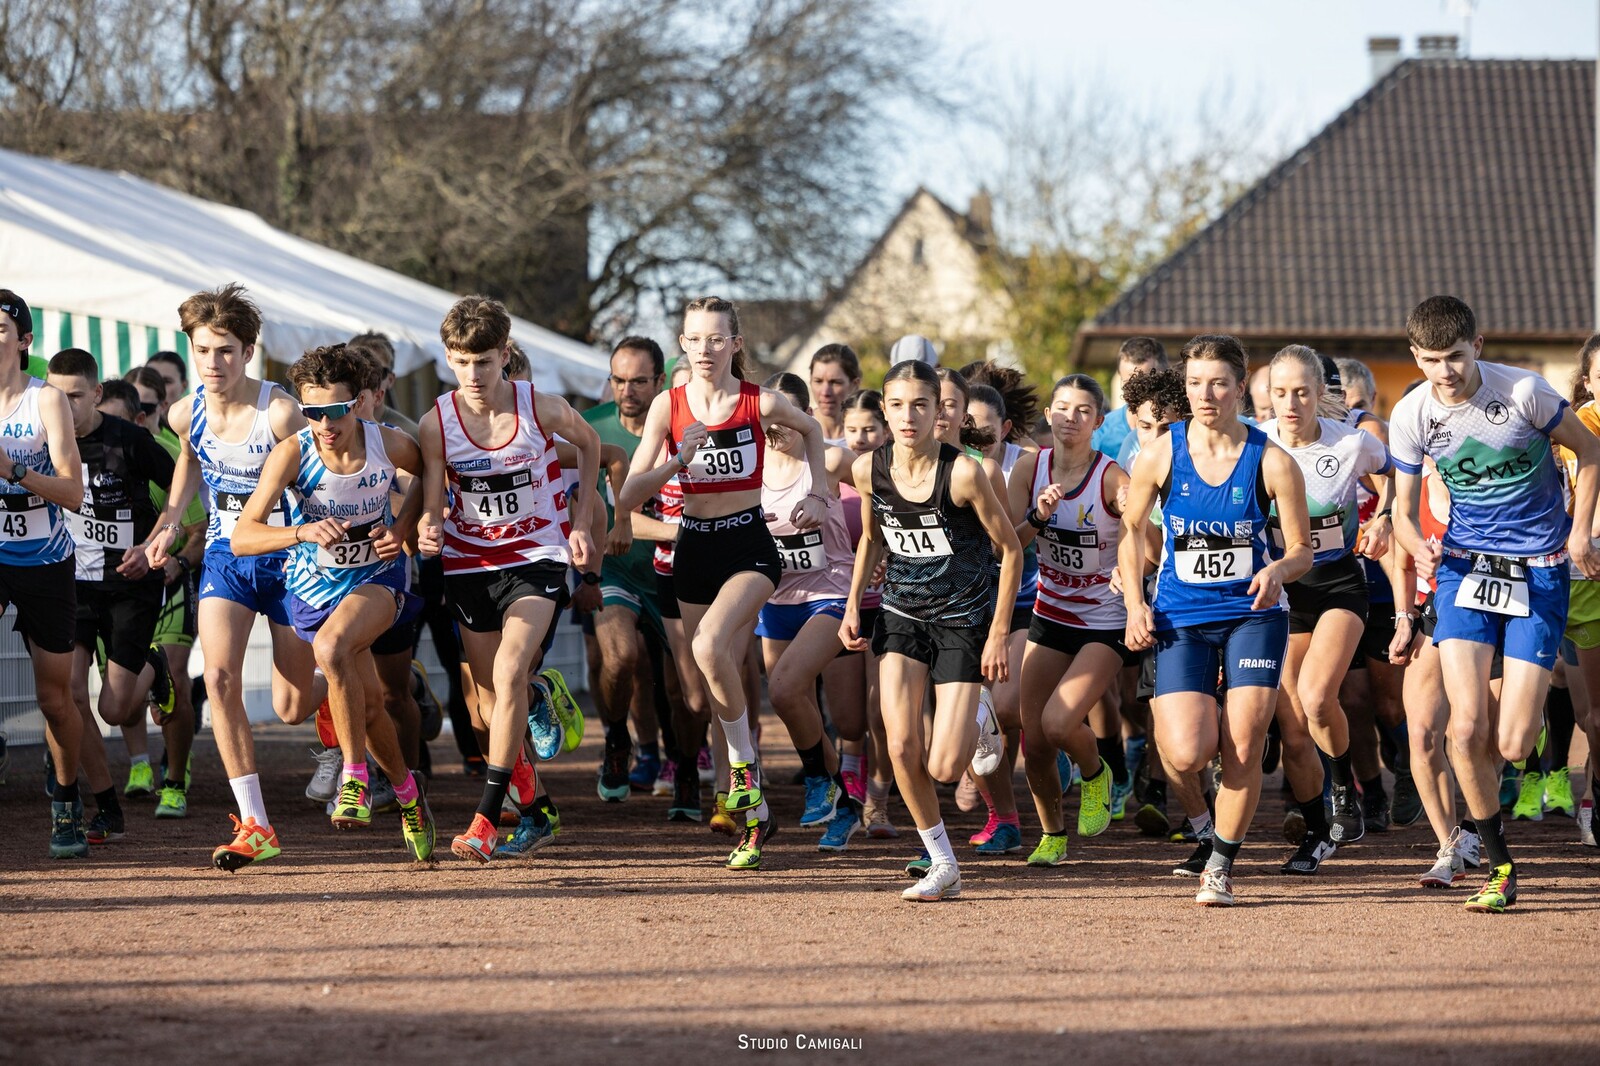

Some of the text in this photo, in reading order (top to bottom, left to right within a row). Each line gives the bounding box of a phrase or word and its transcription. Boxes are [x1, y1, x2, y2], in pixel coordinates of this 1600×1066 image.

[3, 423, 34, 438] ABA
[248, 443, 272, 454] ABA
[703, 449, 744, 476] 399
[358, 469, 388, 489] ABA
[479, 492, 519, 517] 418
[3, 514, 28, 537] 43
[84, 520, 118, 545] 386
[680, 515, 711, 532] NIKE
[714, 513, 753, 531] PRO
[335, 540, 373, 565] 327
[894, 531, 936, 553] 214
[1050, 543, 1084, 570] 353
[1193, 552, 1236, 579] 452
[1473, 578, 1513, 609] 407
[1238, 658, 1277, 670] FRANCE
